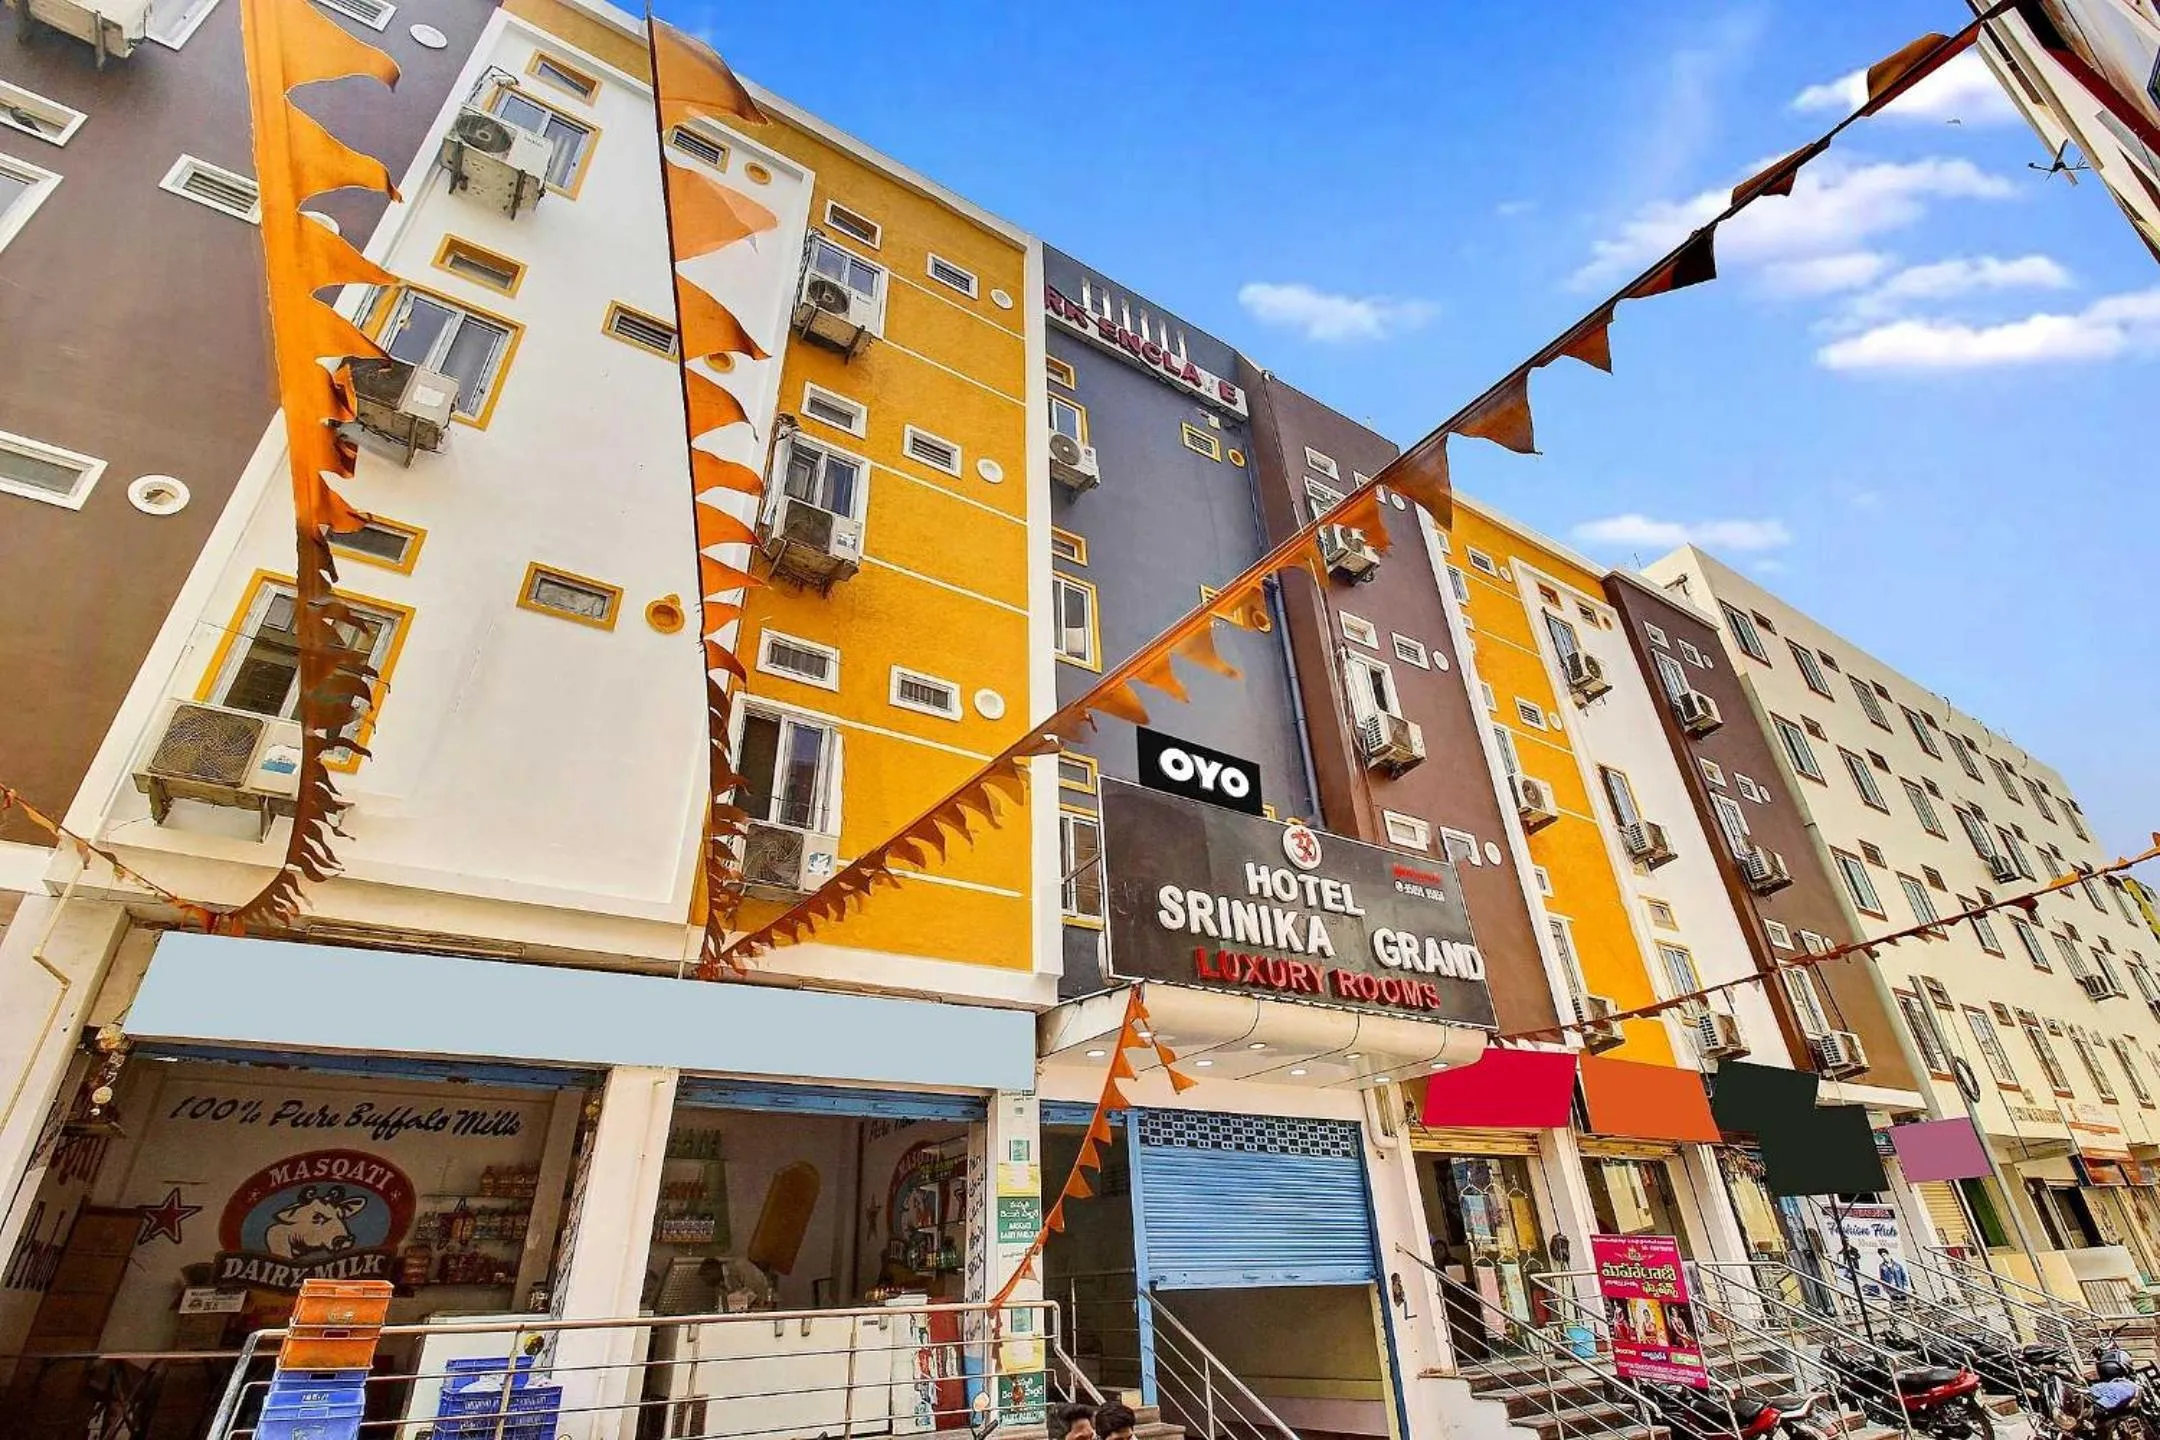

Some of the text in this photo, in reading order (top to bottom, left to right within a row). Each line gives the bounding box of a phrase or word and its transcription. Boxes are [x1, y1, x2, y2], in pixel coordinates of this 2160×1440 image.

[1098, 316, 1238, 406] ENCLAE
[1158, 747, 1250, 799] OYO
[1245, 862, 1366, 917] HOTEL
[1157, 885, 1486, 982] SRINIKA GRAND
[1194, 946, 1442, 1010] LUXURY ROOMS
[169, 1096, 524, 1142] 100% Pure Buffalo Milk
[268, 1157, 395, 1192] MASQATI
[223, 1254, 387, 1290] DAIRY MILK
